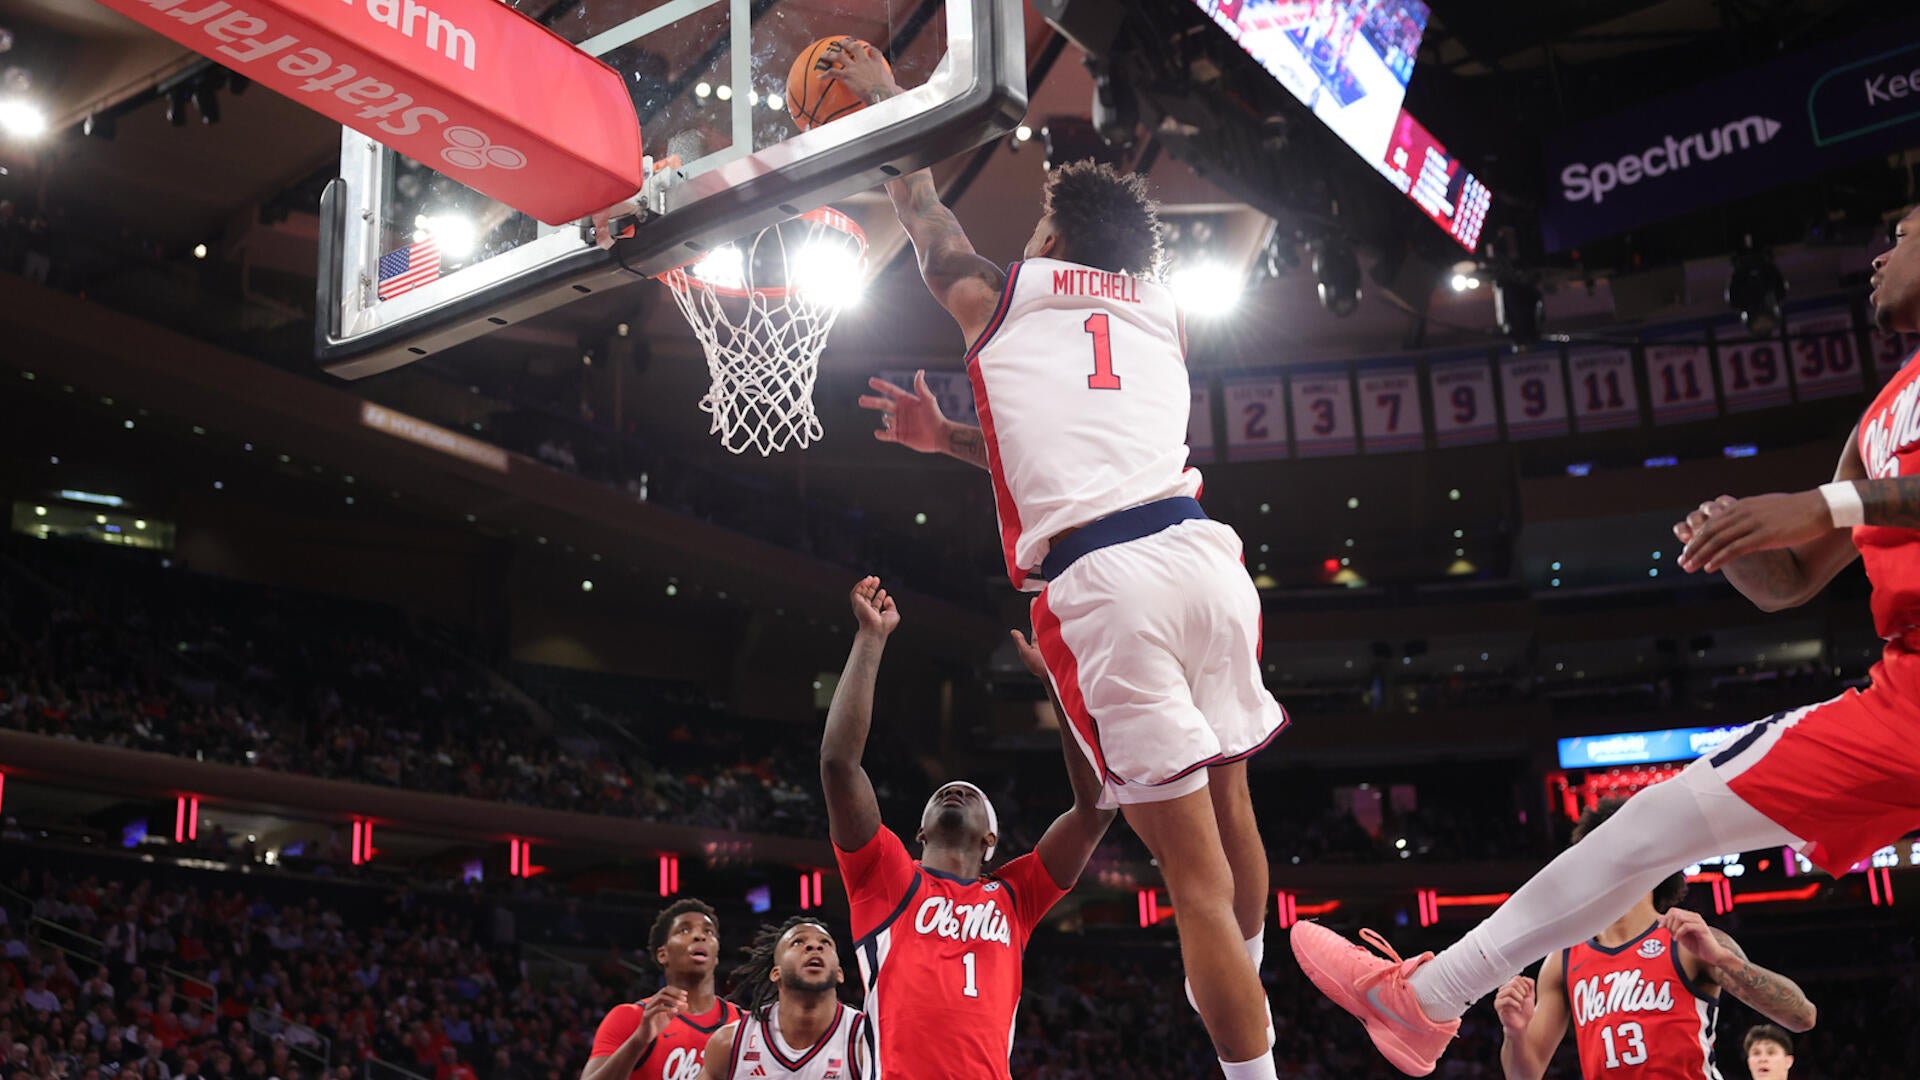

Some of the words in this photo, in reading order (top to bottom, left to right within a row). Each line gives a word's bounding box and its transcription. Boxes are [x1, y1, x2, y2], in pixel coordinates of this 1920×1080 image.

[1561, 115, 1769, 204] Spectrum
[1053, 269, 1141, 303] MITCHELL
[1084, 312, 1121, 390] 1
[1729, 346, 1778, 390] 19
[1798, 330, 1854, 377] 30
[1521, 378, 1547, 417] 9
[1584, 369, 1625, 410] 11
[1662, 359, 1702, 403] 11
[1244, 402, 1268, 439] 2
[1311, 398, 1336, 435] 3
[1376, 394, 1402, 432] 7
[1452, 385, 1479, 424] 9
[915, 896, 960, 940] Ole
[962, 951, 979, 998] 1
[1573, 975, 1606, 1027] Ole
[1603, 968, 1675, 1014] Miss
[1601, 1021, 1648, 1069] 13
